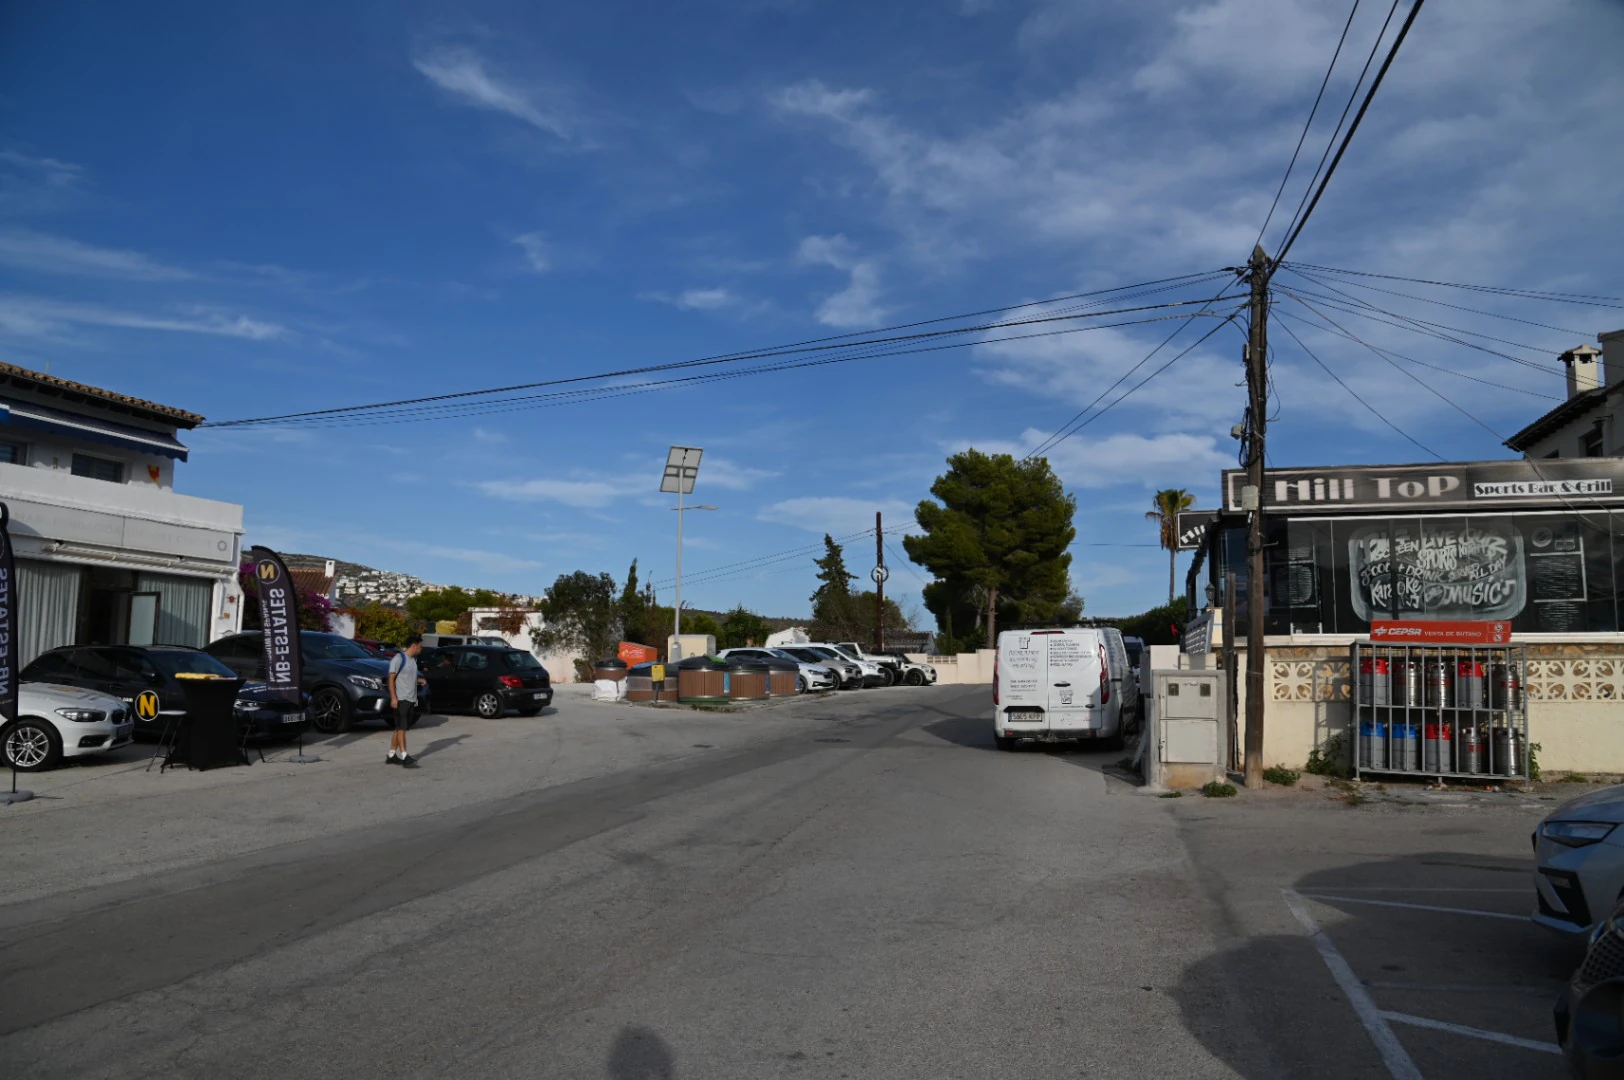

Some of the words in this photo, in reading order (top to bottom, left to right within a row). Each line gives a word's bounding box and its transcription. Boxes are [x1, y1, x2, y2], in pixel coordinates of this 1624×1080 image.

[1275, 477, 1354, 501] Hill
[1475, 483, 1525, 495] Sports
[1528, 482, 1556, 494] Bar
[1561, 481, 1572, 493] &
[1575, 480, 1611, 492] Grill
[1405, 564, 1445, 582] DRINK
[1488, 555, 1506, 574] DAY
[1416, 546, 1458, 571] SPORTS
[1388, 627, 1422, 636] CEPSA
[140, 694, 155, 717] N
